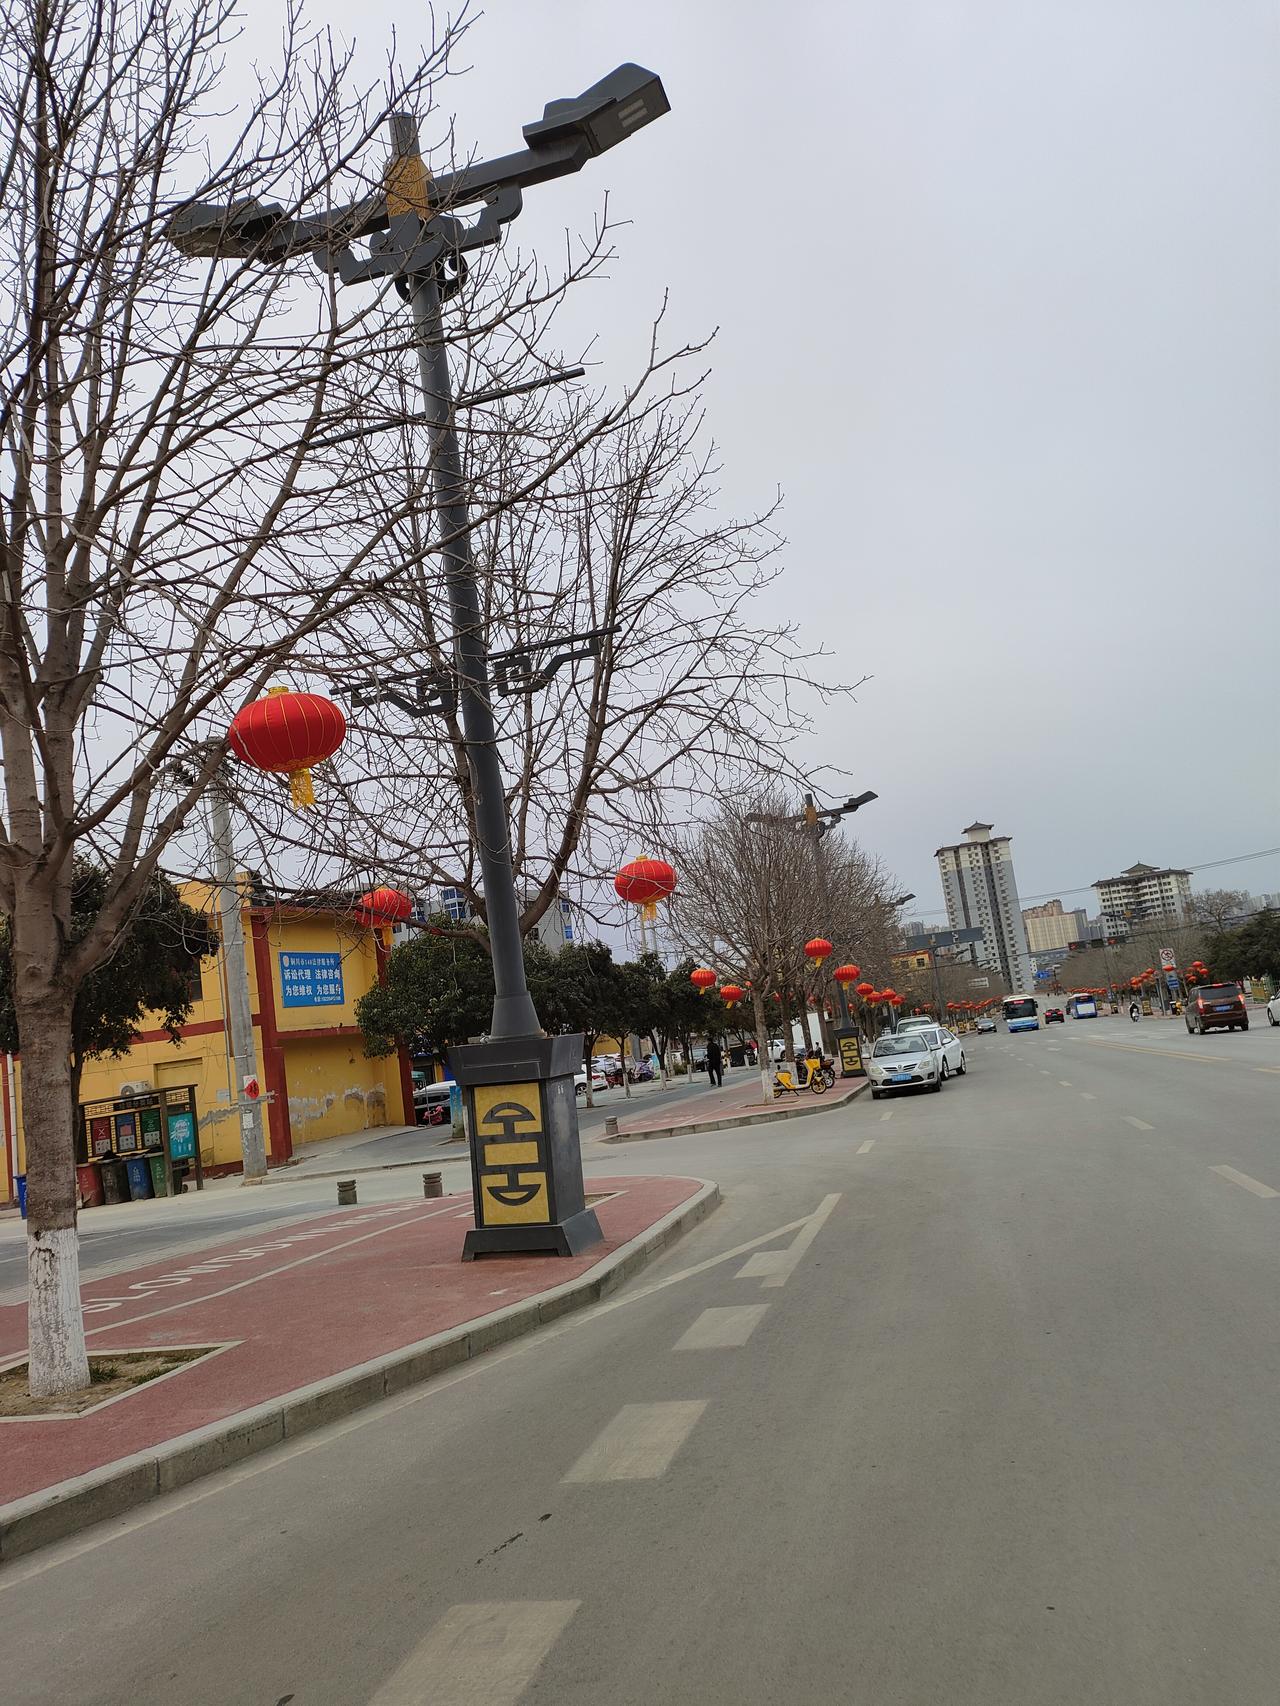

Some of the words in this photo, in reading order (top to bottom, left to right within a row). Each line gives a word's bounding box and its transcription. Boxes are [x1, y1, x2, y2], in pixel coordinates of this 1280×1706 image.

[283, 969, 312, 980] 诉讼代理
[315, 968, 340, 980] 法律咨询
[285, 985, 313, 996] 为您维权
